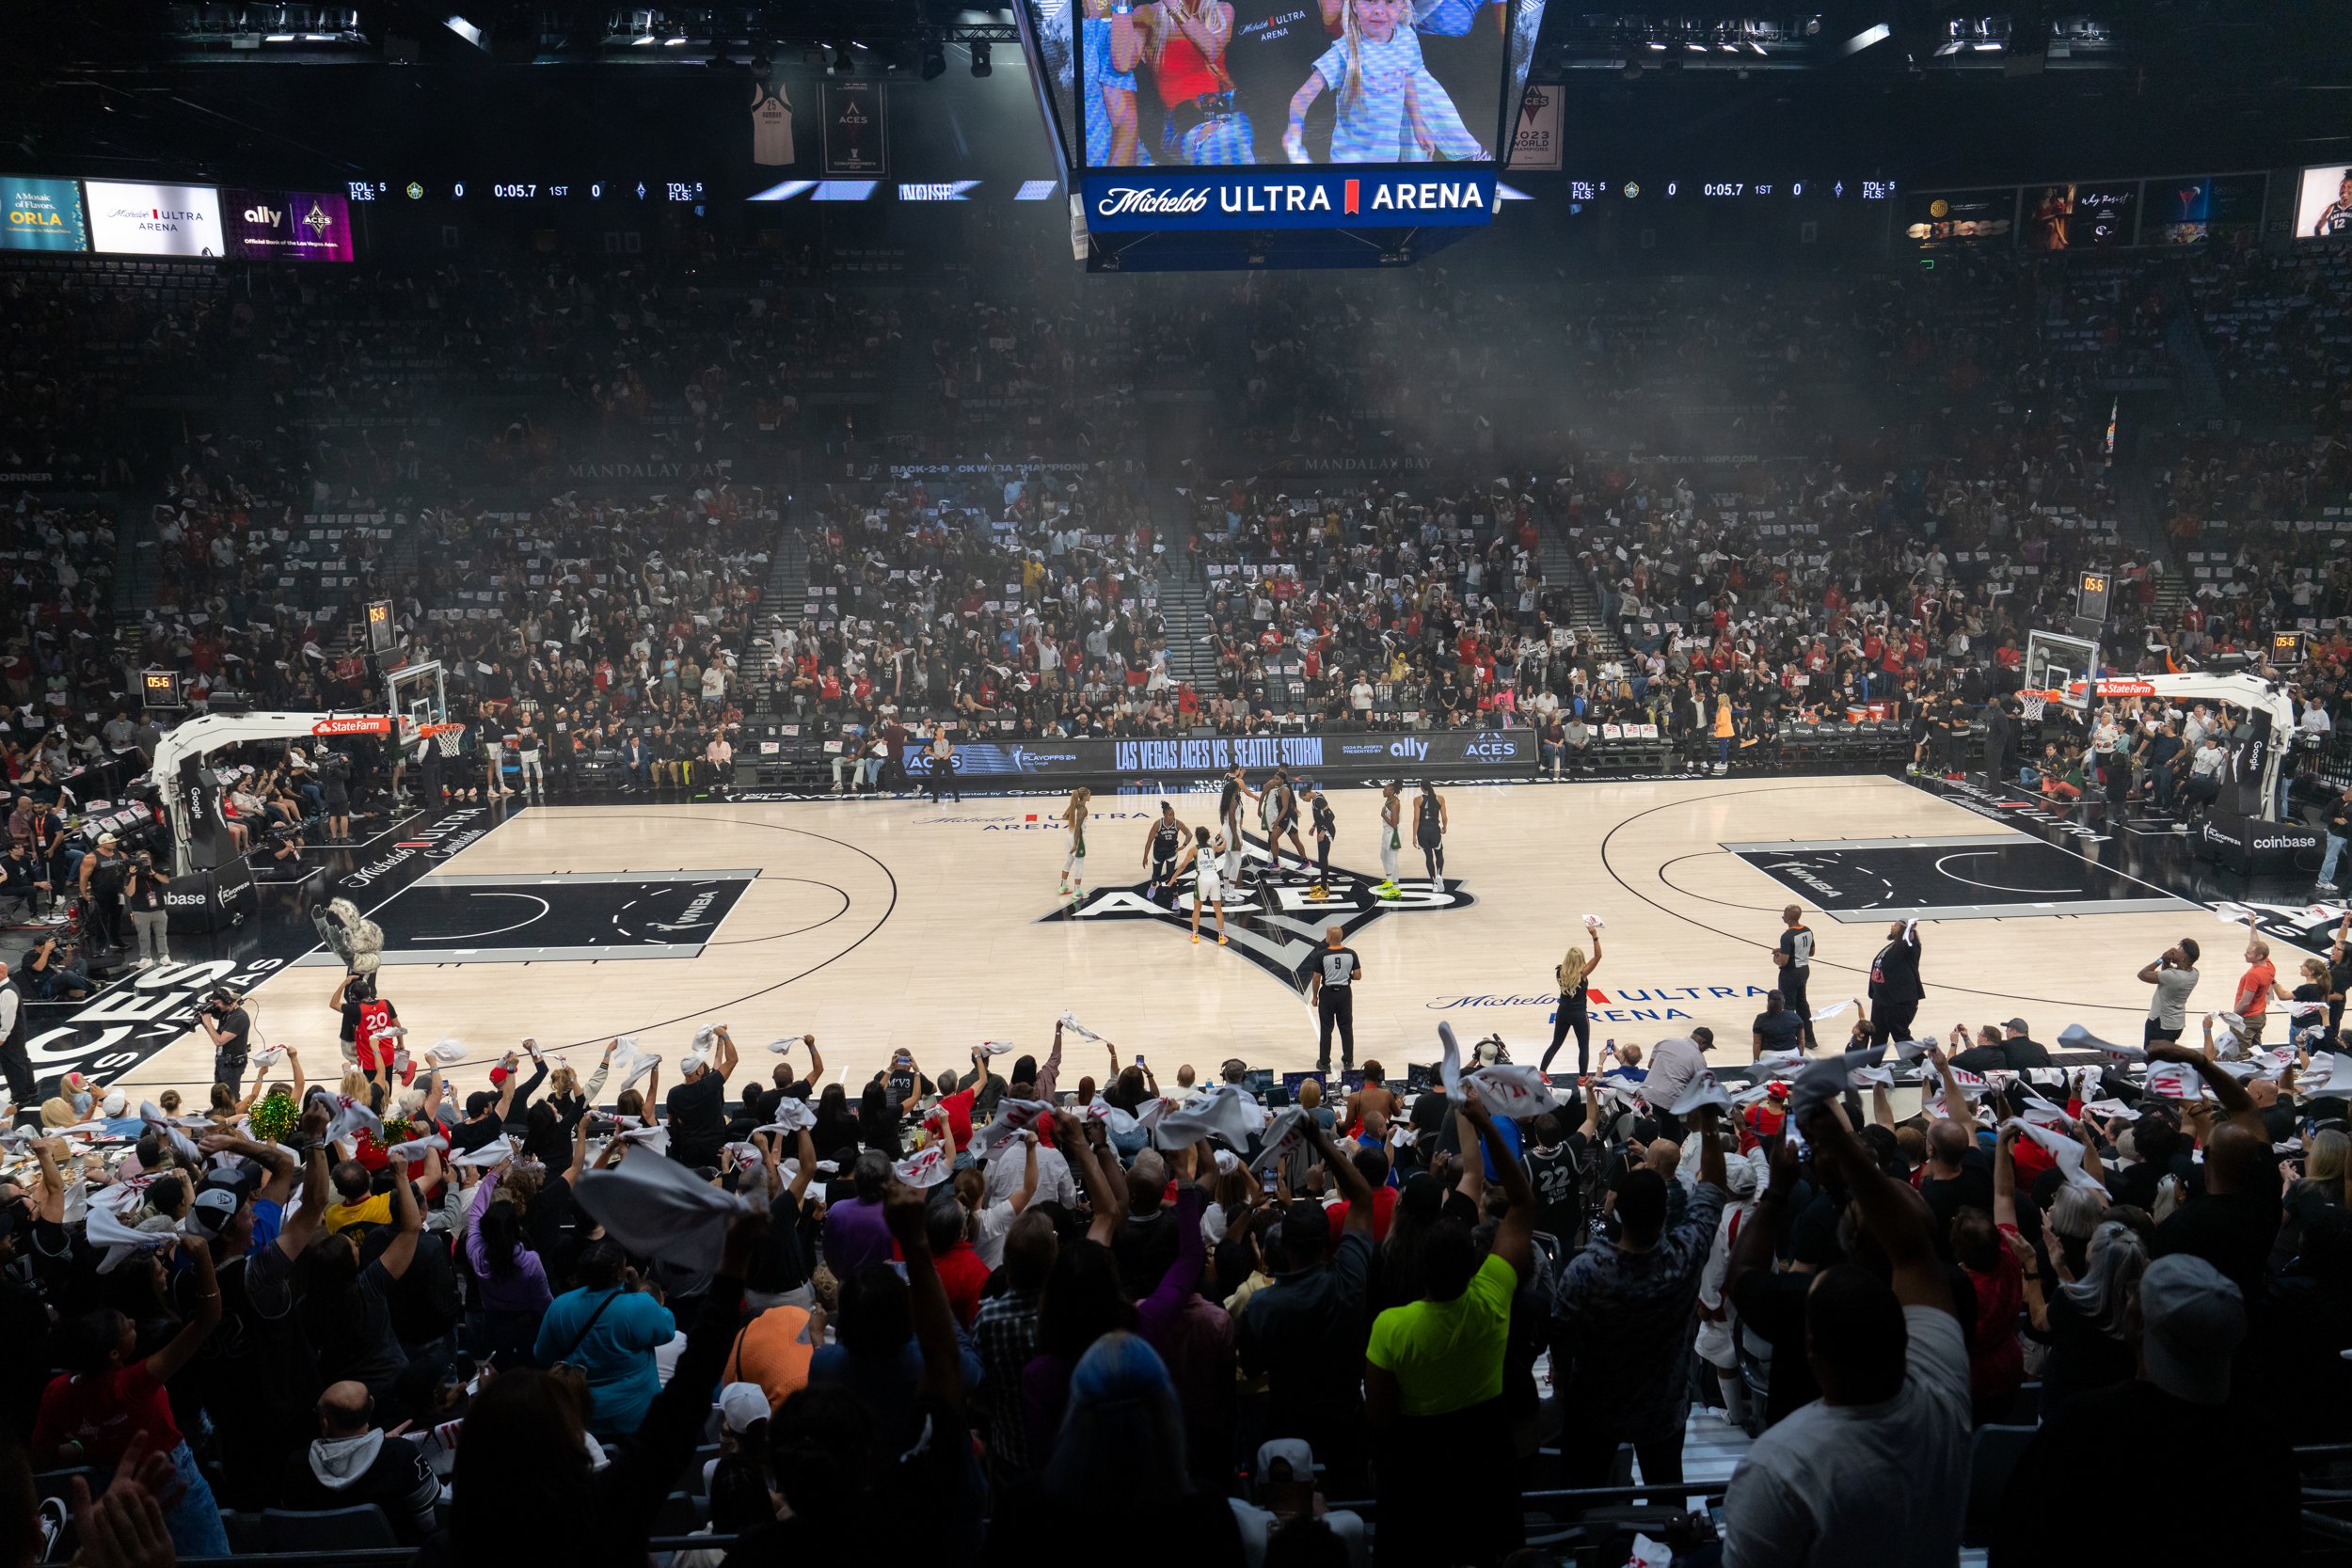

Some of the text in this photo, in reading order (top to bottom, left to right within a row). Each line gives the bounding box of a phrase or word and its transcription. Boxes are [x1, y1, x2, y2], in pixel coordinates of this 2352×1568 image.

[1276, 10, 1306, 24] ULTRA
[1261, 27, 1289, 41] ARENA
[348, 182, 387, 192] TOL: 5
[454, 183, 464, 197] 0
[494, 183, 537, 198] 0:05.7
[548, 186, 568, 196] 1ST
[591, 184, 600, 198] 0
[667, 182, 703, 193] TOL: 5
[1571, 182, 1606, 192] TOL: 5
[1668, 182, 1677, 196] 0
[1704, 182, 1743, 196] 0:05.7
[1754, 184, 1773, 194] 1ST
[1793, 182, 1802, 196] 0
[1863, 182, 1896, 192] TOL: 5
[22, 193, 52, 201] Mosaic
[351, 191, 374, 200] FLS:
[669, 192, 692, 201] FLS:
[1098, 182, 1485, 216] Michelob ULTRA ARENA
[1573, 191, 1595, 199] FLS:
[1864, 190, 1884, 199] FLS:
[15, 200, 24, 209] of
[9, 211, 63, 226] ORLA
[161, 211, 203, 221] ULTRA
[244, 206, 282, 228] ally
[138, 222, 179, 232] ARENA
[2333, 219, 2345, 230] 12
[568, 463, 683, 478] MANDALAY
[1305, 457, 1435, 470] MANDALAY BAY
[1115, 736, 1324, 770] LAS VEGAS ACES VS. SEATTLE STORM
[1390, 737, 1429, 762] ally
[1466, 743, 1516, 756] ACES
[2249, 741, 2262, 771] Google
[909, 755, 961, 769] ACS
[1631, 771, 1703, 781] Google
[1007, 788, 1076, 797] Googl
[191, 786, 203, 819] Google
[1048, 812, 1151, 821] UTRA
[2015, 808, 2113, 843] ULTRA
[339, 807, 487, 888] Michelob ULTRA
[2253, 834, 2316, 849] coinbase
[1202, 848, 1211, 860] 4
[1786, 867, 1844, 898] WNBA
[675, 891, 720, 924] WNBA
[1802, 935, 1808, 948] 11
[1334, 957, 1342, 970] 9
[1616, 985, 1770, 1002] ULTRA
[366, 1011, 388, 1031] 20
[1538, 1165, 1570, 1193] 22
